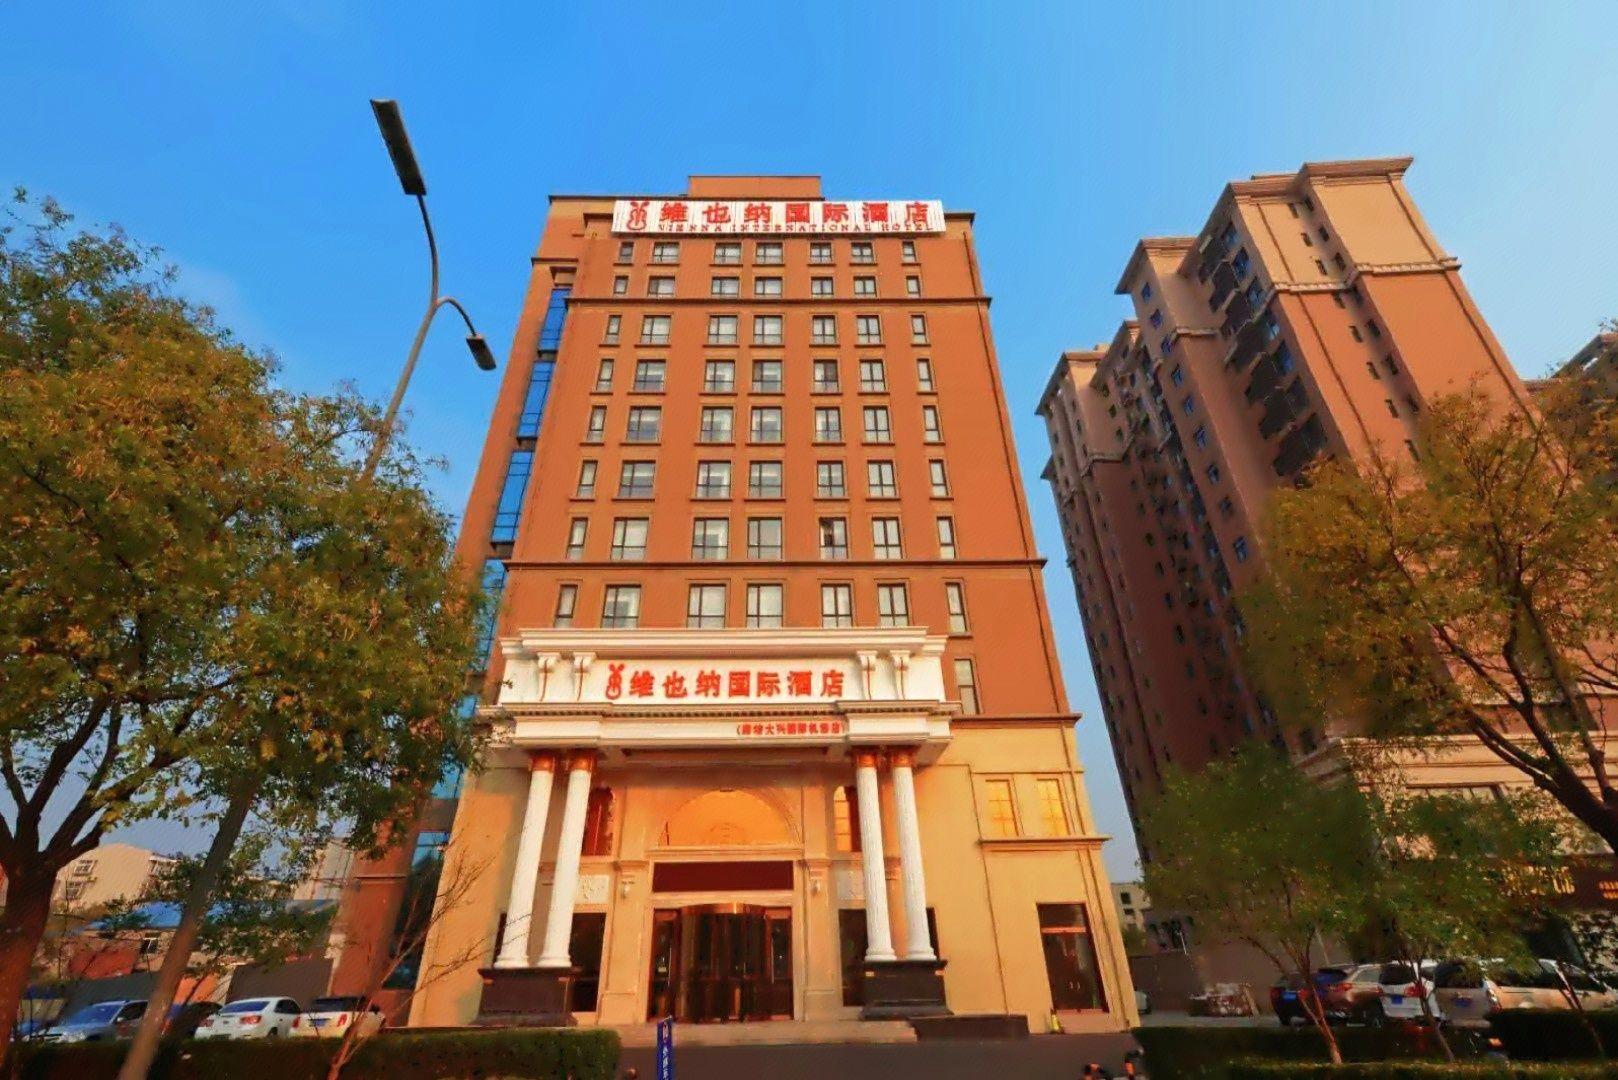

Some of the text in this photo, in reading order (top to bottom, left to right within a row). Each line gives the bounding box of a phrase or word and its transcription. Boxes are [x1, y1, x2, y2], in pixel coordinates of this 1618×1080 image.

[660, 202, 928, 224] 维也纳国际酒店
[630, 671, 844, 698] 维也纳国际酒店
